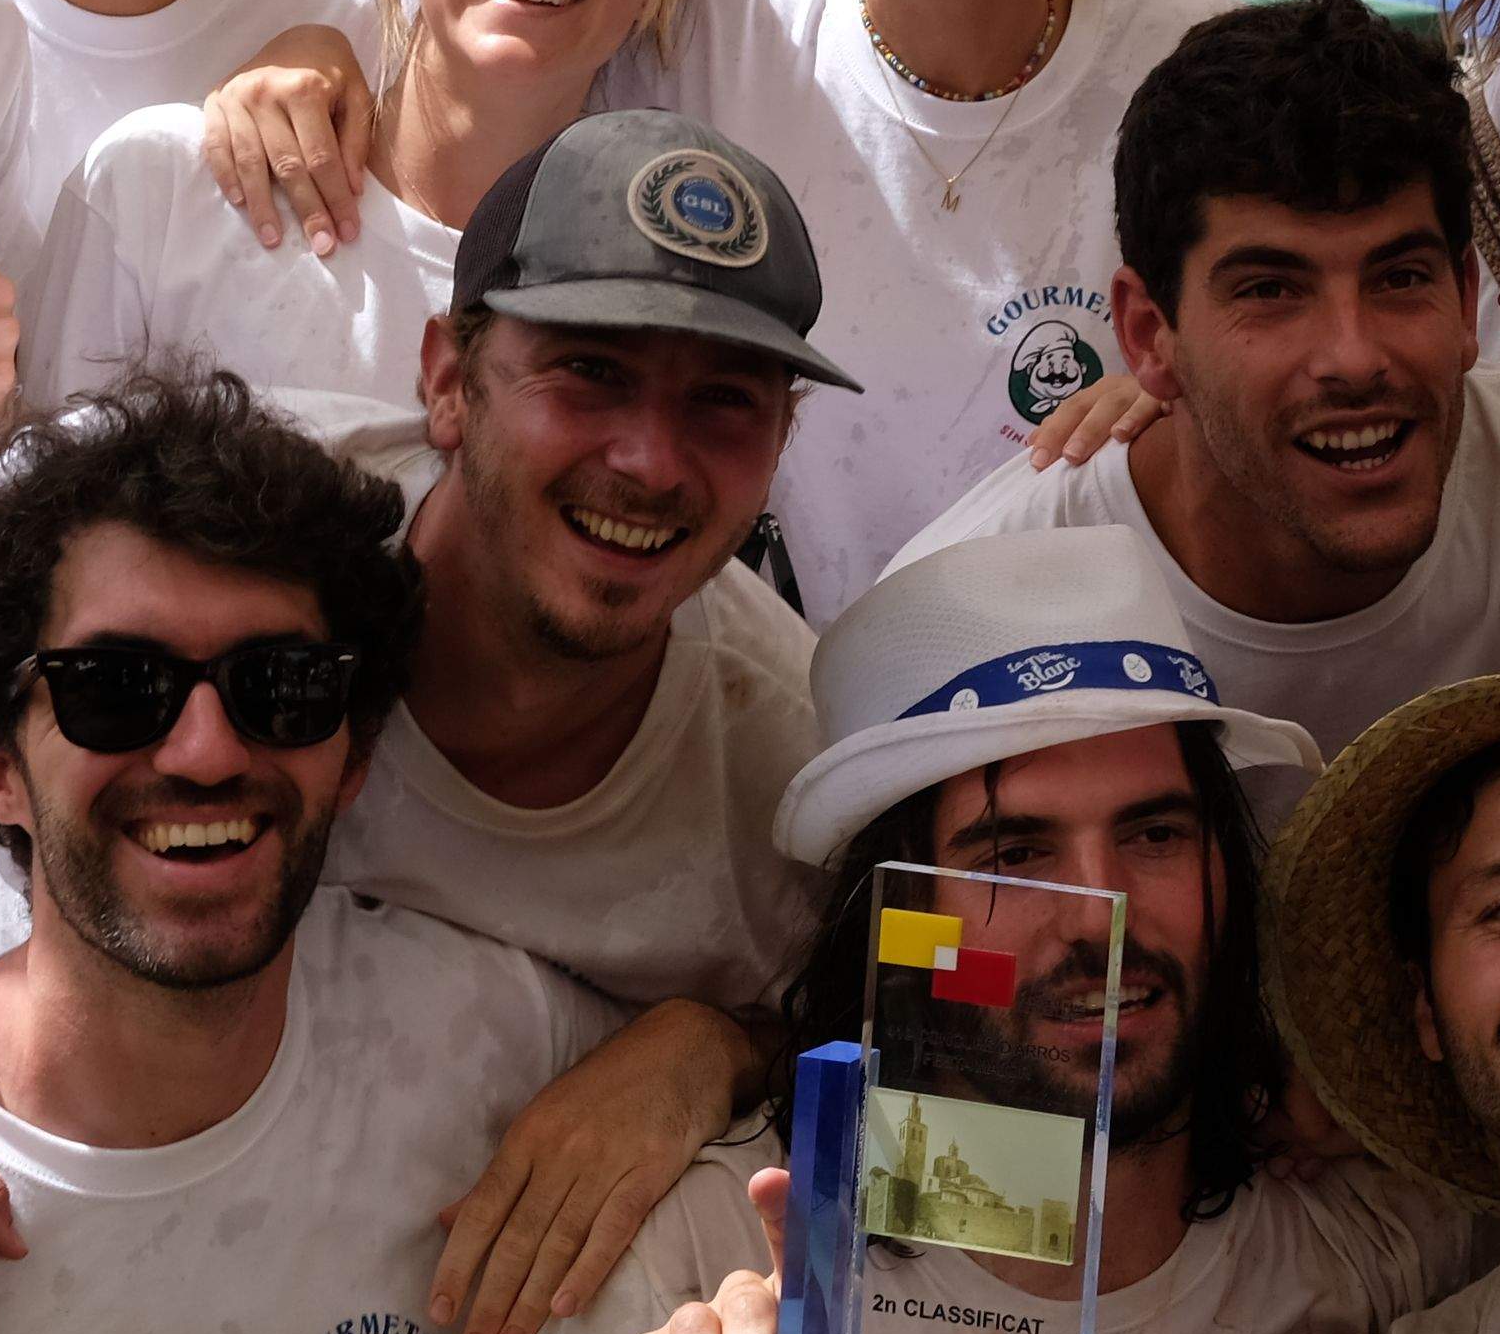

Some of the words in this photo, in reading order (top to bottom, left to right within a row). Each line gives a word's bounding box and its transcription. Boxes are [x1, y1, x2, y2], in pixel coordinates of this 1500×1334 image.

[1000, 425, 1029, 447] SIN
[1017, 657, 1081, 691] Blanc
[872, 1294, 896, 1314] 2n
